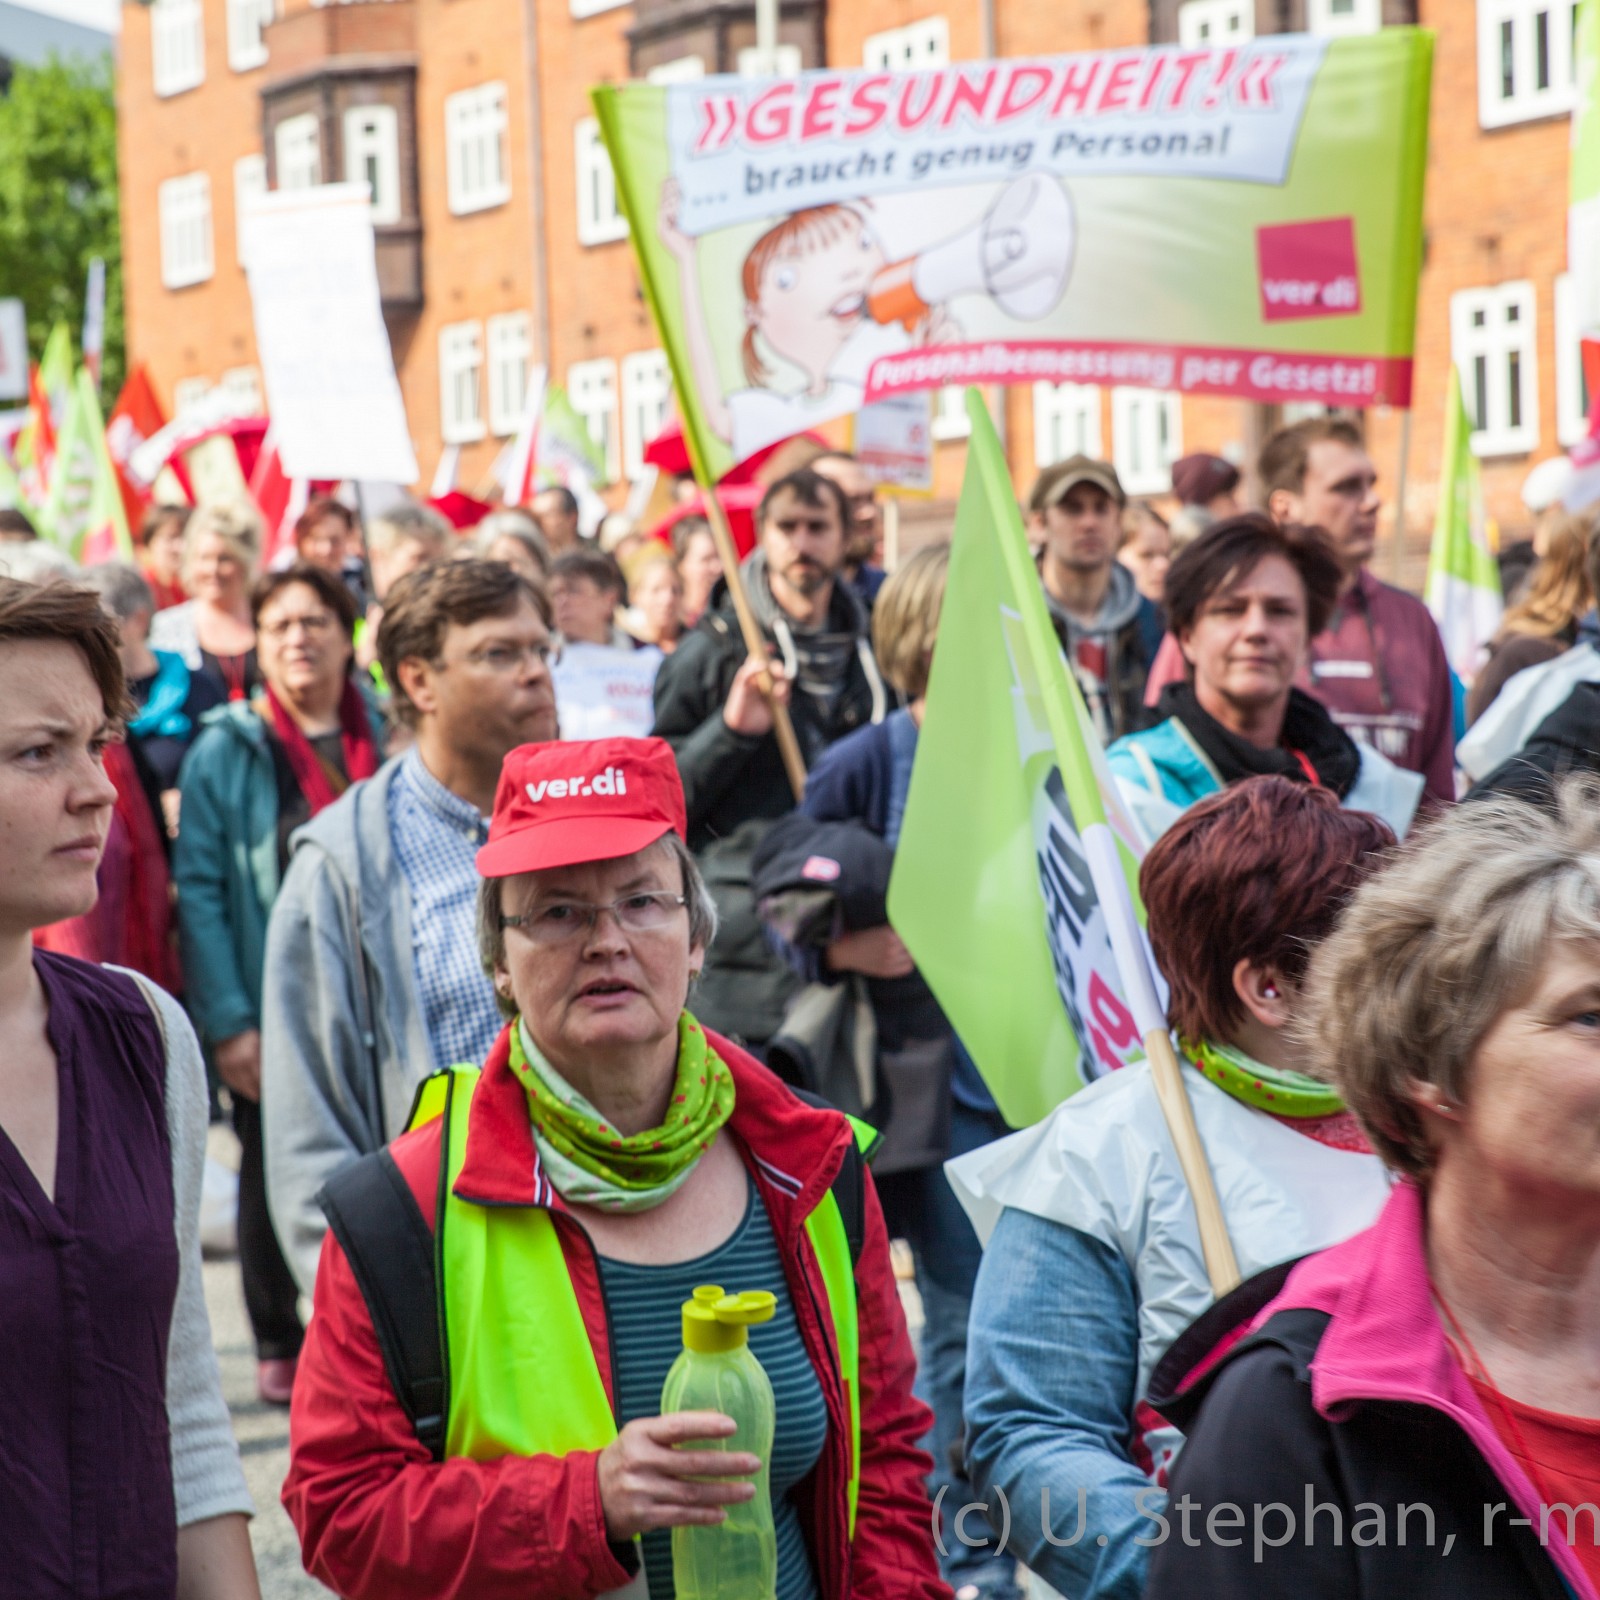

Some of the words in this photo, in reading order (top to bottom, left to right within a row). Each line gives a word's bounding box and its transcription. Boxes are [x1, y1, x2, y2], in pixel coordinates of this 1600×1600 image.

[743, 149, 896, 196] braucht
[910, 139, 1034, 180] genug
[1051, 123, 1232, 160] Personal
[1262, 275, 1358, 308] ver.di
[870, 344, 1174, 391] Personalbemessung
[1180, 355, 1241, 390] per
[1249, 355, 1376, 395] Gesetz!
[525, 766, 627, 803] ver.di
